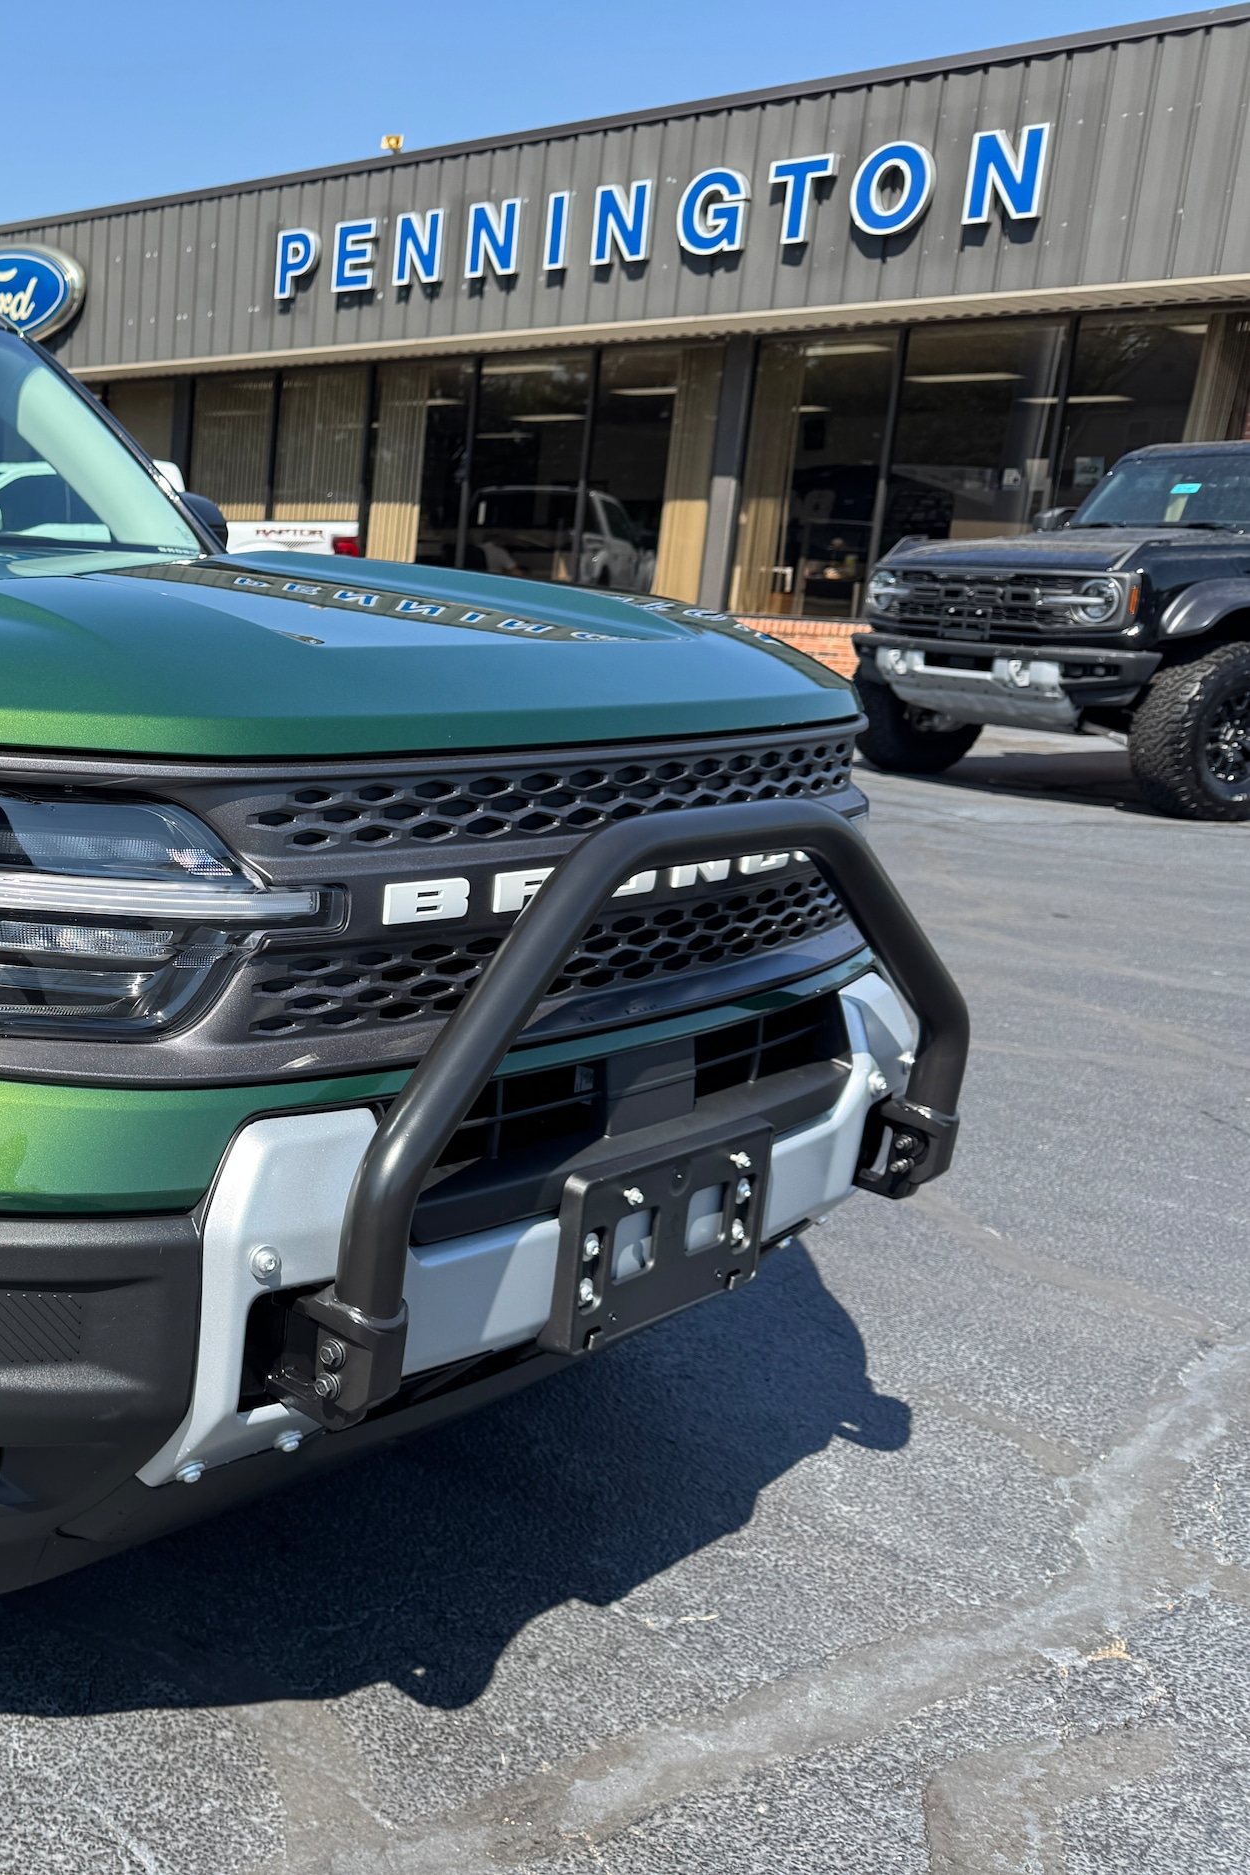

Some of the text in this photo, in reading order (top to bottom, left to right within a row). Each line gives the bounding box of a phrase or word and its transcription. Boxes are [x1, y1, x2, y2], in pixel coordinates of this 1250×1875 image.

[274, 122, 1051, 299] PENNINGTON
[255, 528, 325, 538] RAPTOR
[382, 850, 813, 926] BRNC
